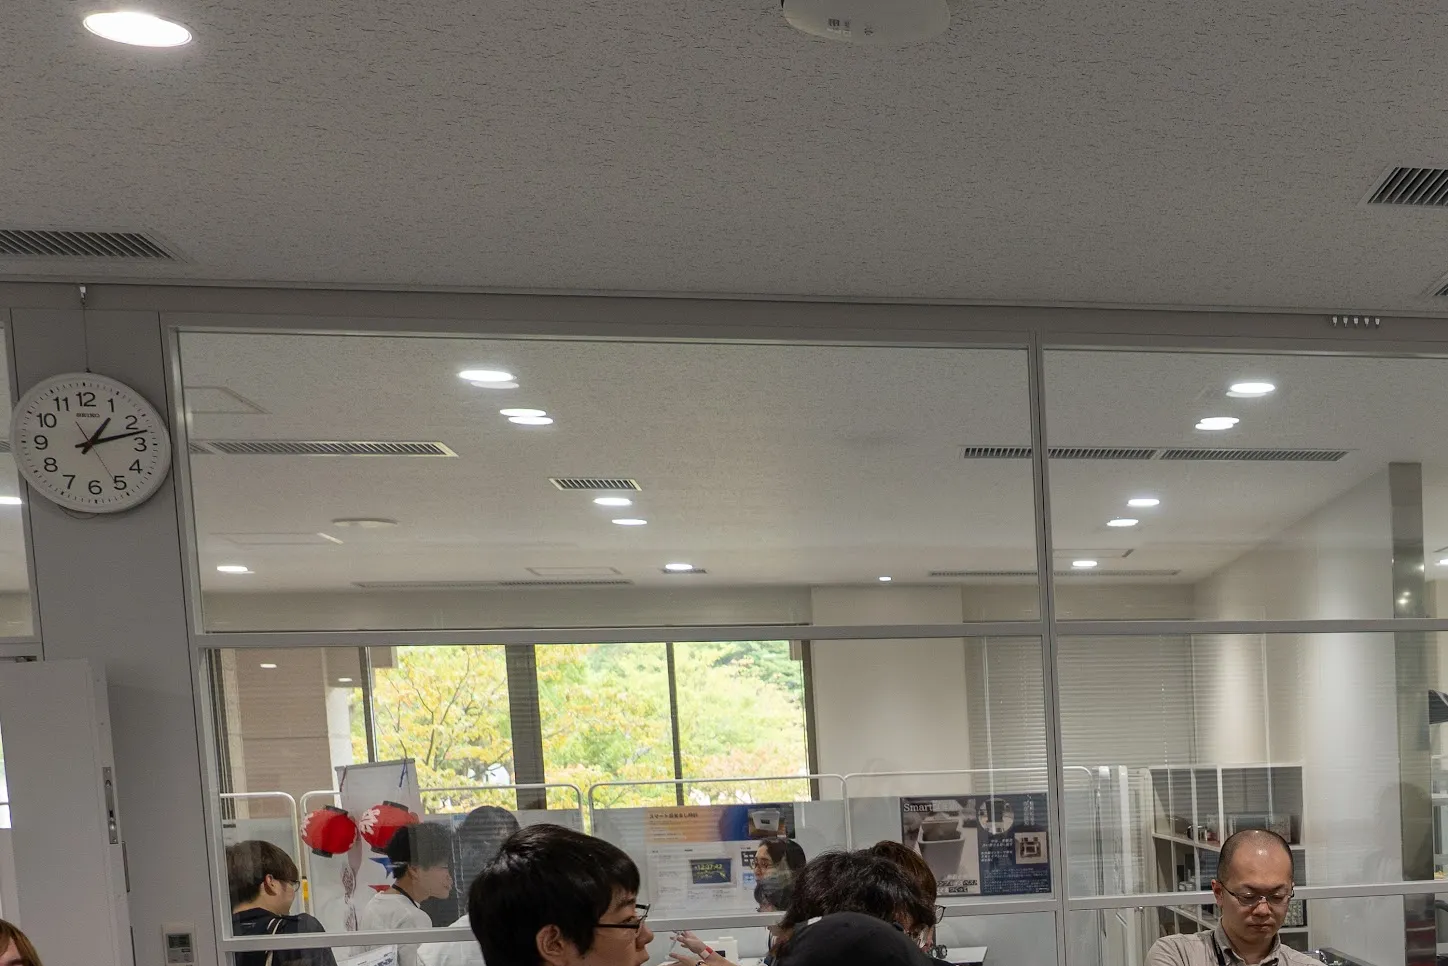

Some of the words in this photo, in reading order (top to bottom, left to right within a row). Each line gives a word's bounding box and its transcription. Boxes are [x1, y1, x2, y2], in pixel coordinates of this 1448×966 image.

[54, 397, 70, 412] 11
[76, 392, 96, 407] 12
[108, 398, 115, 413] 1
[37, 413, 57, 428] 10
[125, 415, 138, 430] 2
[33, 435, 48, 450] 9
[134, 437, 147, 452] 3
[43, 457, 58, 472] 8
[129, 459, 143, 474] 4
[63, 474, 76, 490] 7
[88, 480, 103, 495] 6
[113, 475, 127, 491] 5
[903, 803, 933, 812] Smart
